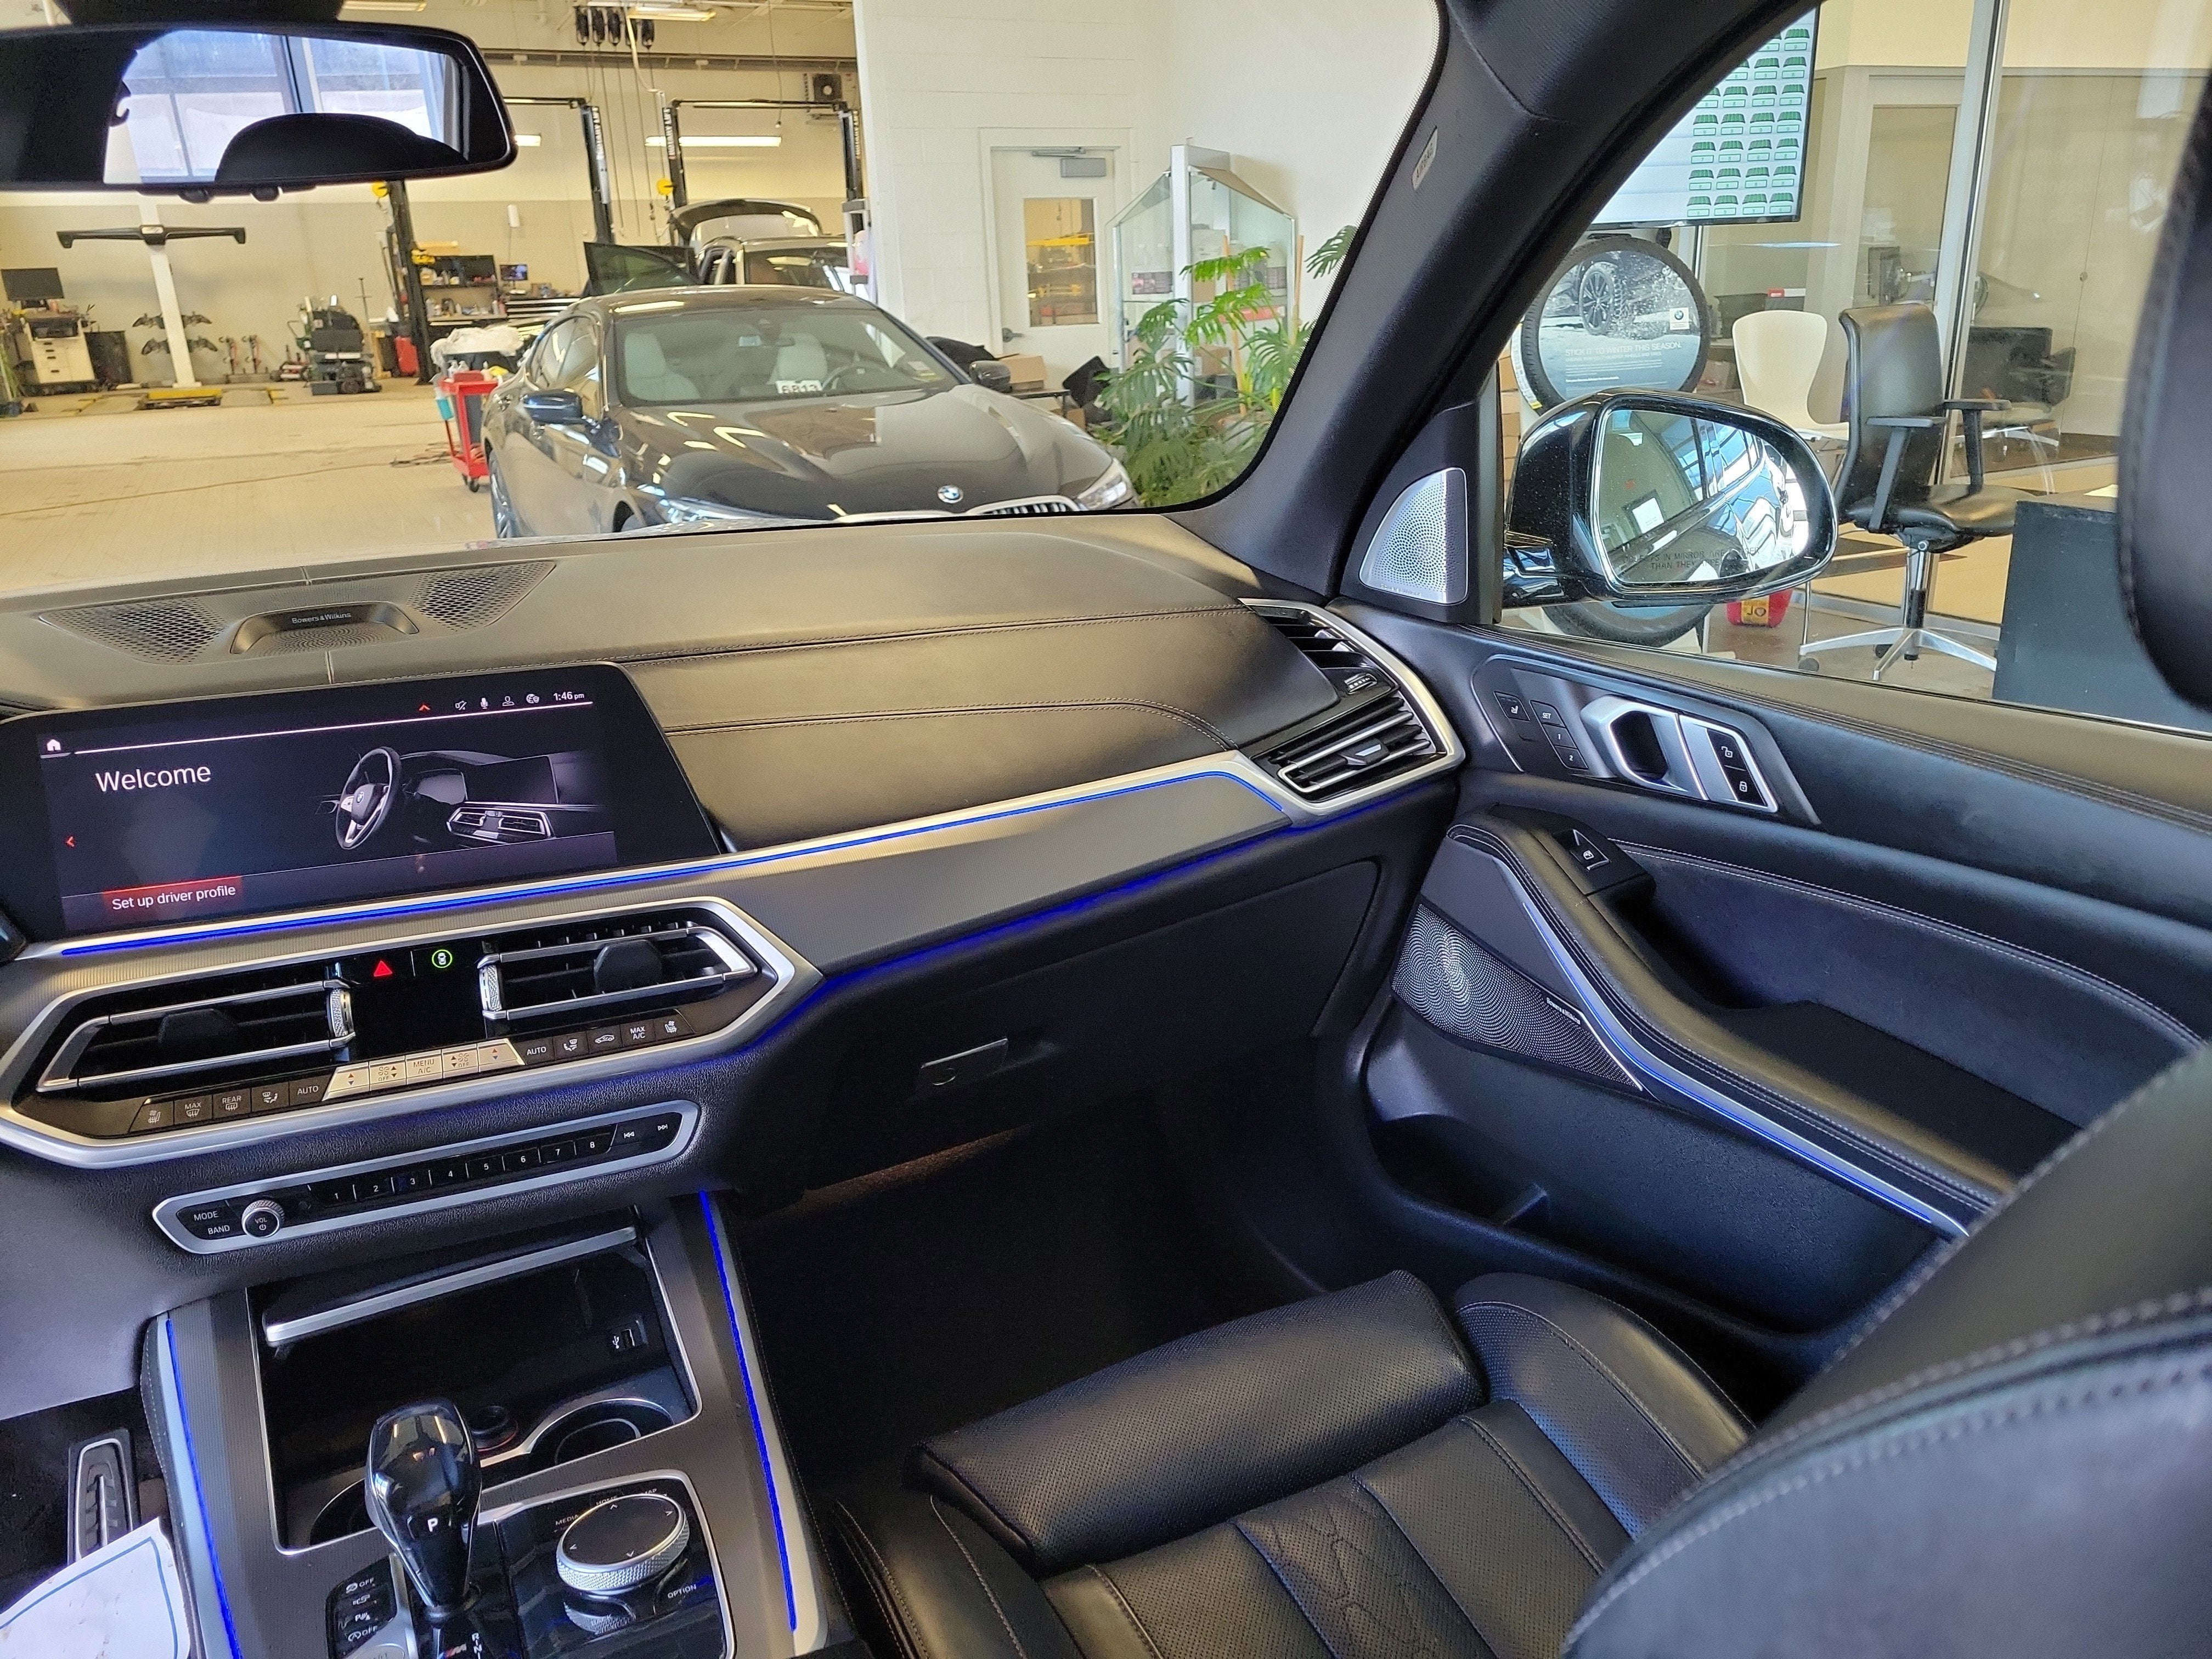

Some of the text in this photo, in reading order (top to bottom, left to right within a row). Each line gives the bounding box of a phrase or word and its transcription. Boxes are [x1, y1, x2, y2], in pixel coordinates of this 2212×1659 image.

[1606, 345, 1633, 354] WINTER
[1651, 341, 1682, 351] SEASON.
[1674, 551, 1705, 560] MIRROR
[1651, 562, 1673, 570] THAN
[1675, 560, 1696, 568] THEY
[553, 691, 573, 701] 1:46
[95, 766, 212, 792] Welcome
[112, 885, 236, 910] Set up driver profile
[630, 1025, 646, 1034] MAX
[633, 1032, 646, 1040] A/C
[526, 1046, 546, 1056] AUTO
[413, 1058, 435, 1068] MENU
[297, 1085, 319, 1095] AUTO
[222, 1095, 241, 1104] REAR
[184, 1102, 202, 1110] MAX
[193, 1210, 219, 1221] MODE
[207, 1224, 230, 1234] BAND
[427, 1517, 439, 1532] P
[555, 1514, 579, 1526] MEDIA
[667, 1583, 697, 1599] OPTION
[471, 1632, 479, 1641] R
[473, 1645, 483, 1654] N
